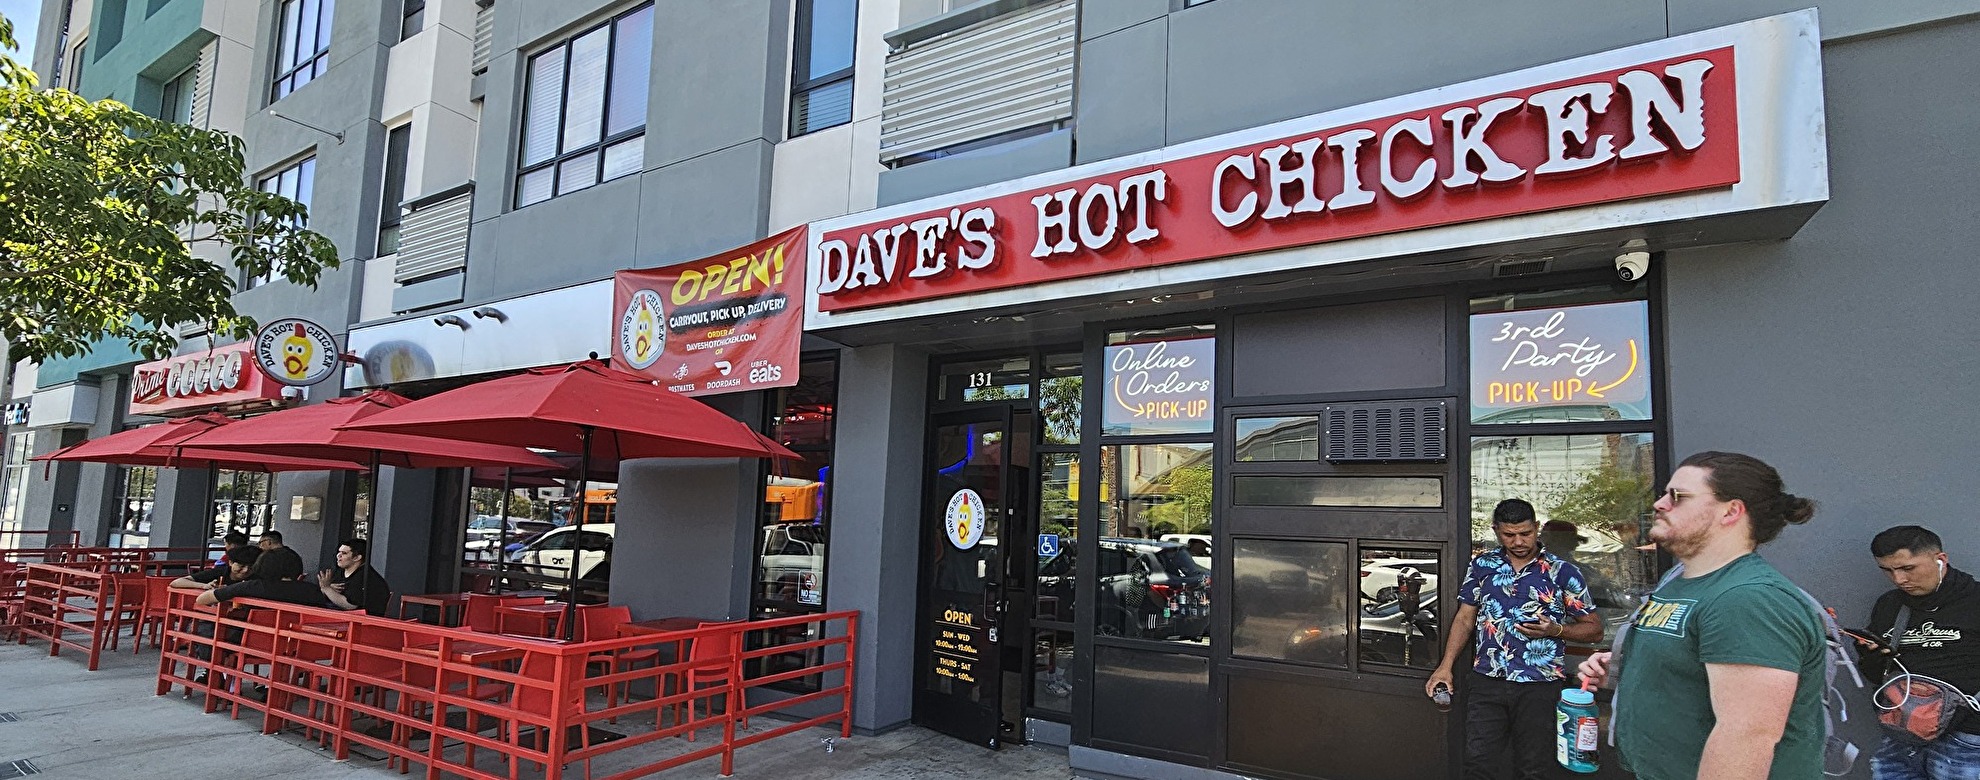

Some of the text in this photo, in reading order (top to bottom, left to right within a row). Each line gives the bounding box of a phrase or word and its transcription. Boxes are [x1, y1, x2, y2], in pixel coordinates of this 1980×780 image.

[817, 58, 1715, 294] DAVE'S HOT CHICKEN
[671, 243, 785, 306] OPEN!
[623, 294, 664, 352] DAVE'S HOT CHICKEN
[669, 297, 786, 329] CARRYOUT, PICK UP, DELIVERY
[707, 329, 728, 338] ORDER
[1491, 311, 1565, 342] 3rd
[261, 322, 334, 368] DAVE'S HOT CHICKEN
[686, 333, 757, 352] DAVESHOTCHICKEN.COM
[751, 360, 768, 368] UBER
[1112, 341, 1197, 372] Online
[1501, 337, 1616, 377] Party
[131, 368, 165, 399] Prime
[706, 379, 741, 389] DOORDASH
[749, 364, 782, 383] eats
[969, 372, 992, 387] 131
[1126, 371, 1210, 396] Orders
[1489, 378, 1583, 404] PICK-UP
[1146, 399, 1208, 419] PICK-UP
[944, 609, 972, 625] OPEN
[942, 630, 954, 639] SUN
[957, 633, 970, 642] WED
[940, 657, 957, 668] THURS
[961, 662, 971, 671] SAT
